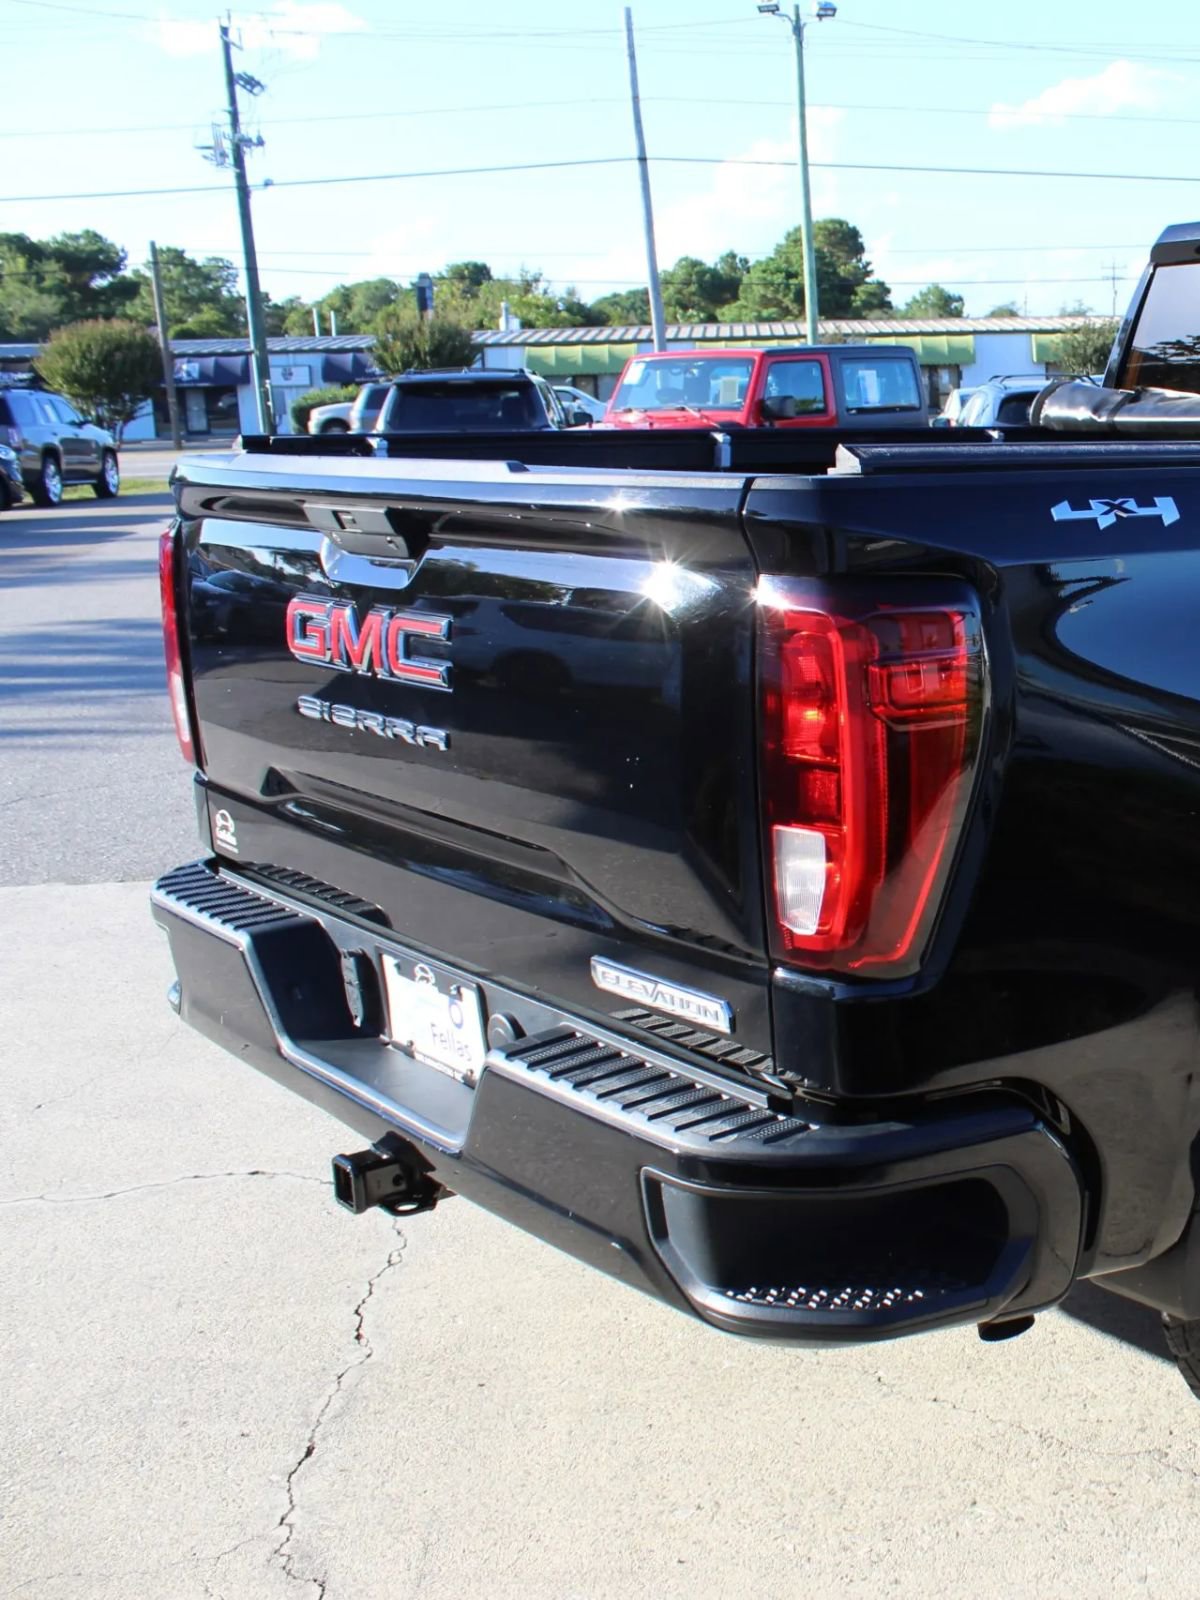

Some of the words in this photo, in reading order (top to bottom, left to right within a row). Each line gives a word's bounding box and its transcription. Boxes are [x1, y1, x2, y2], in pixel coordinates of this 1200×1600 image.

[286, 593, 452, 692] GMC
[298, 695, 450, 751] SIERRA
[601, 970, 720, 1022] ELEVATION
